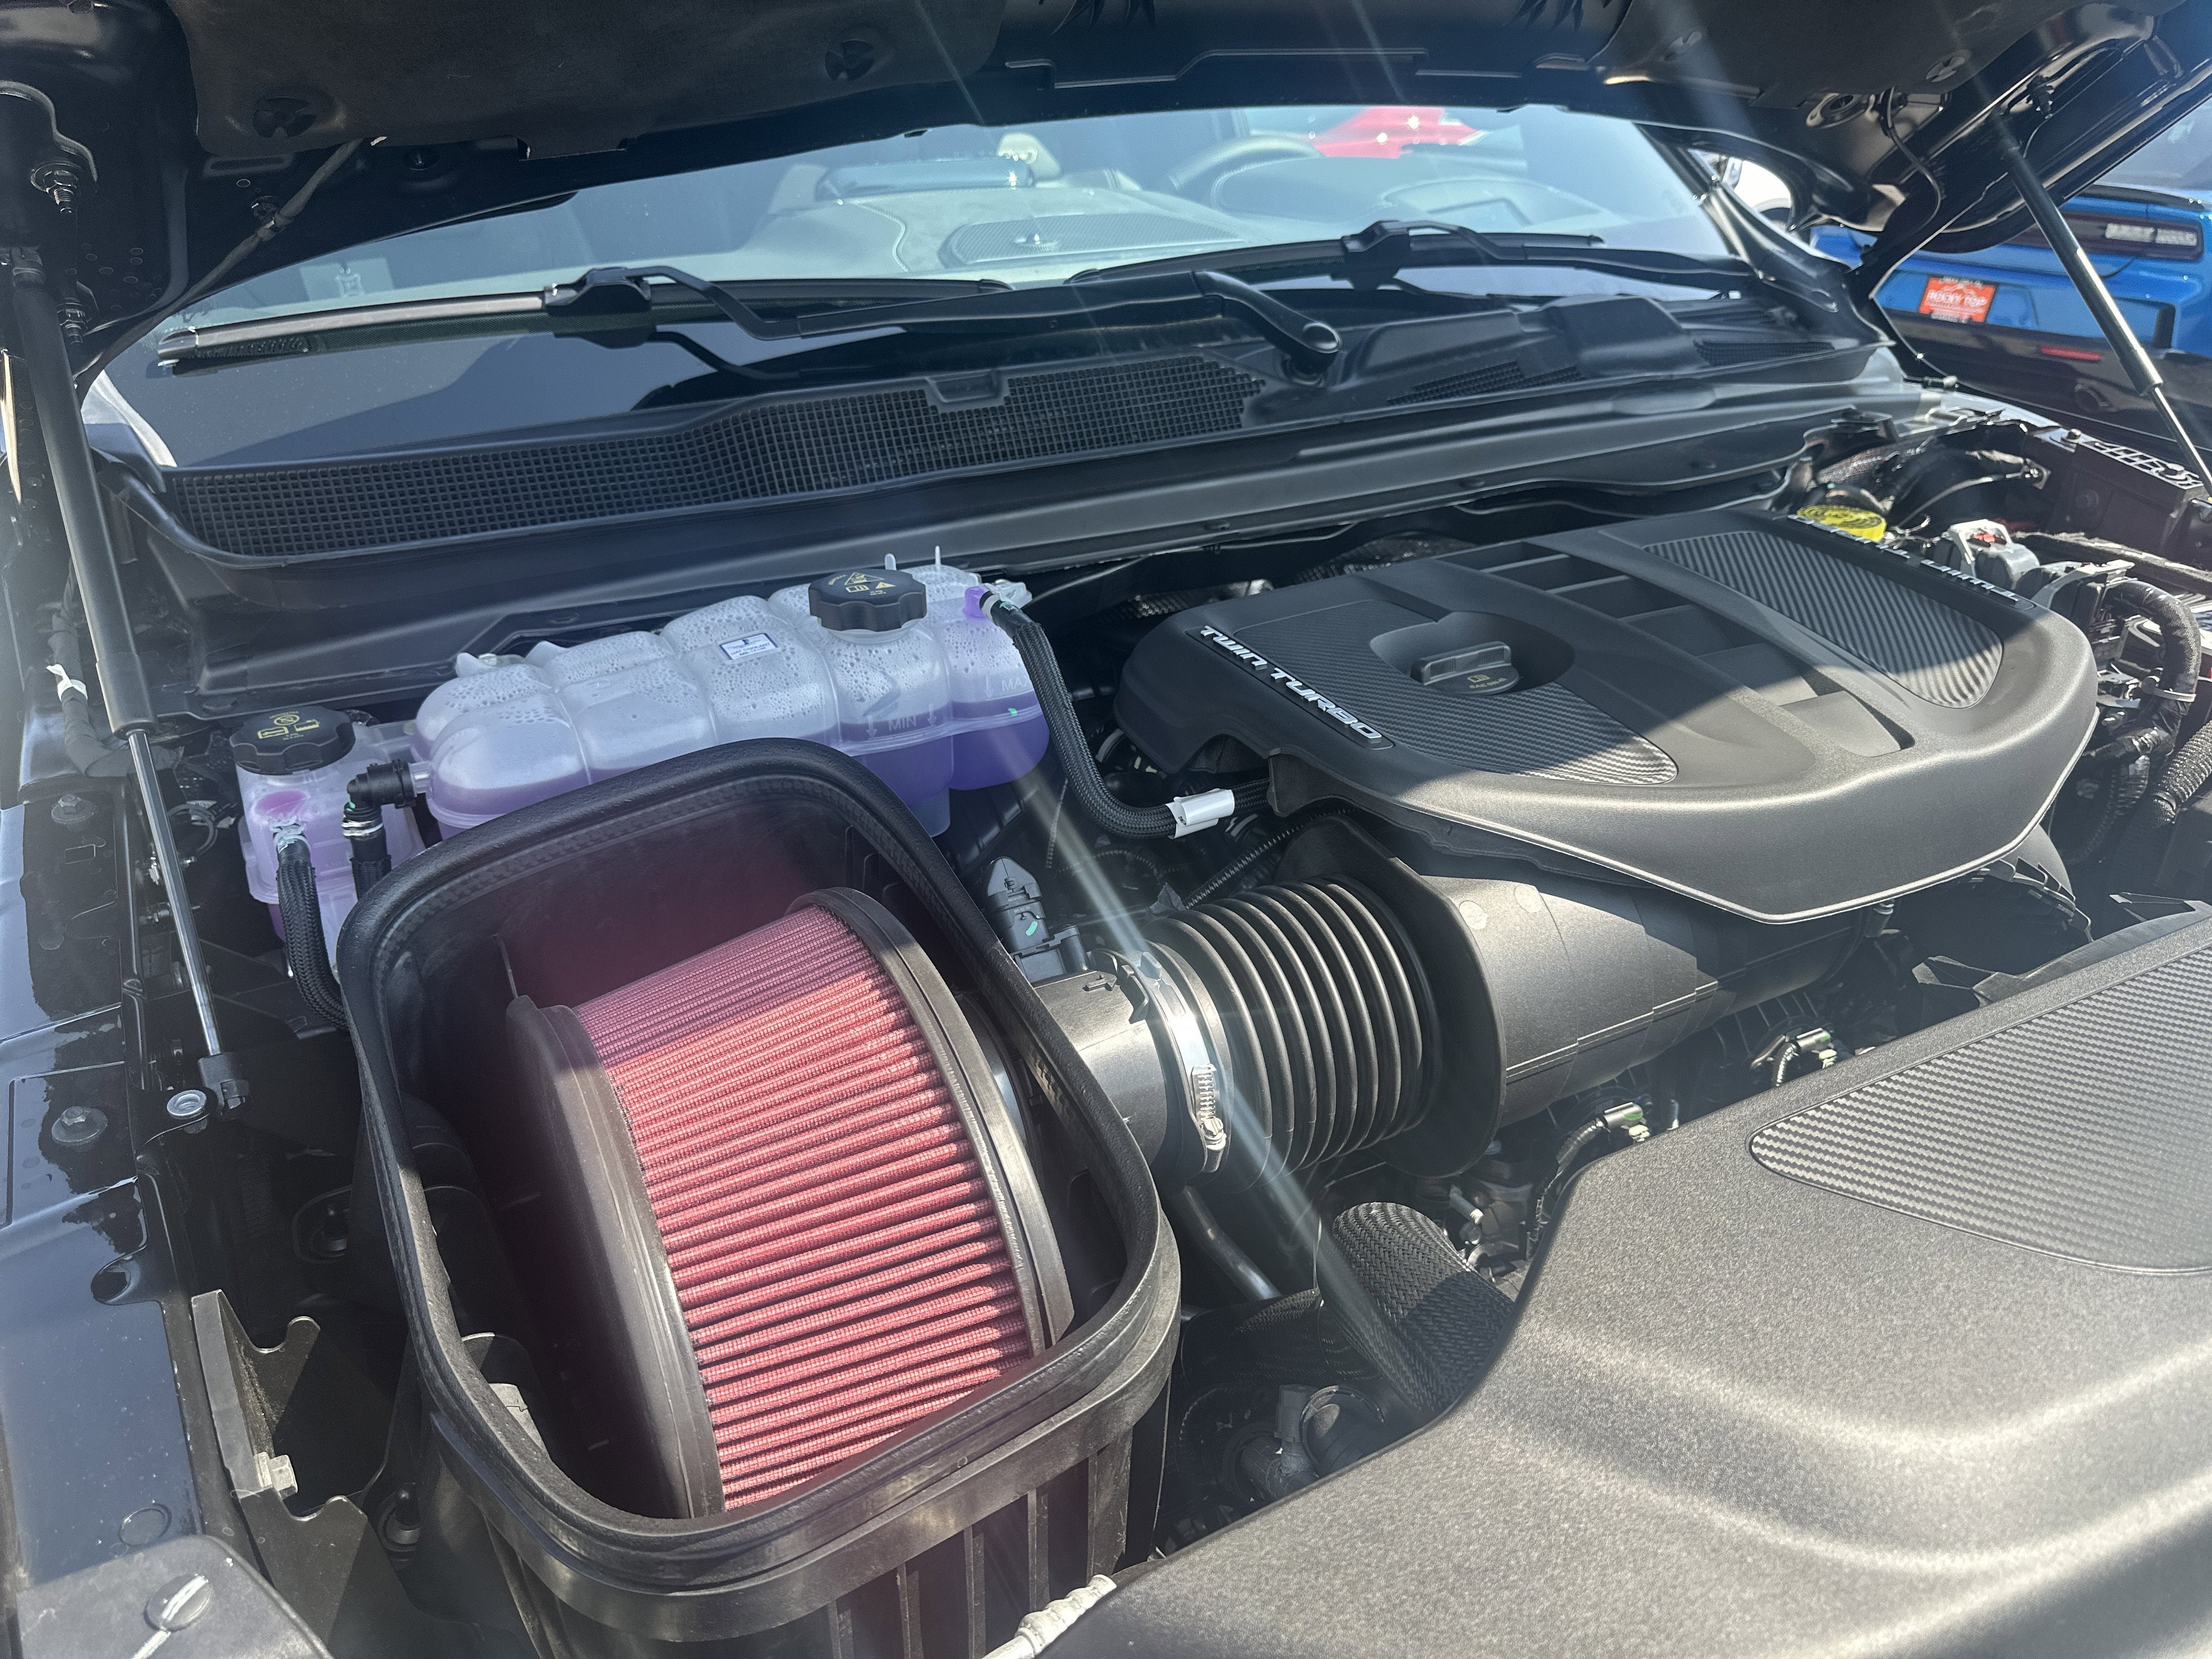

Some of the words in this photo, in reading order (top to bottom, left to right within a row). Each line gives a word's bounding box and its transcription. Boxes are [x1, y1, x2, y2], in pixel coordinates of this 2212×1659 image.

[1964, 295, 1988, 307] TOP
[1002, 675, 1031, 692] MAX
[1200, 625, 1268, 667] TWIN
[1271, 668, 1383, 740] TURBO
[888, 715, 917, 732] MIN
